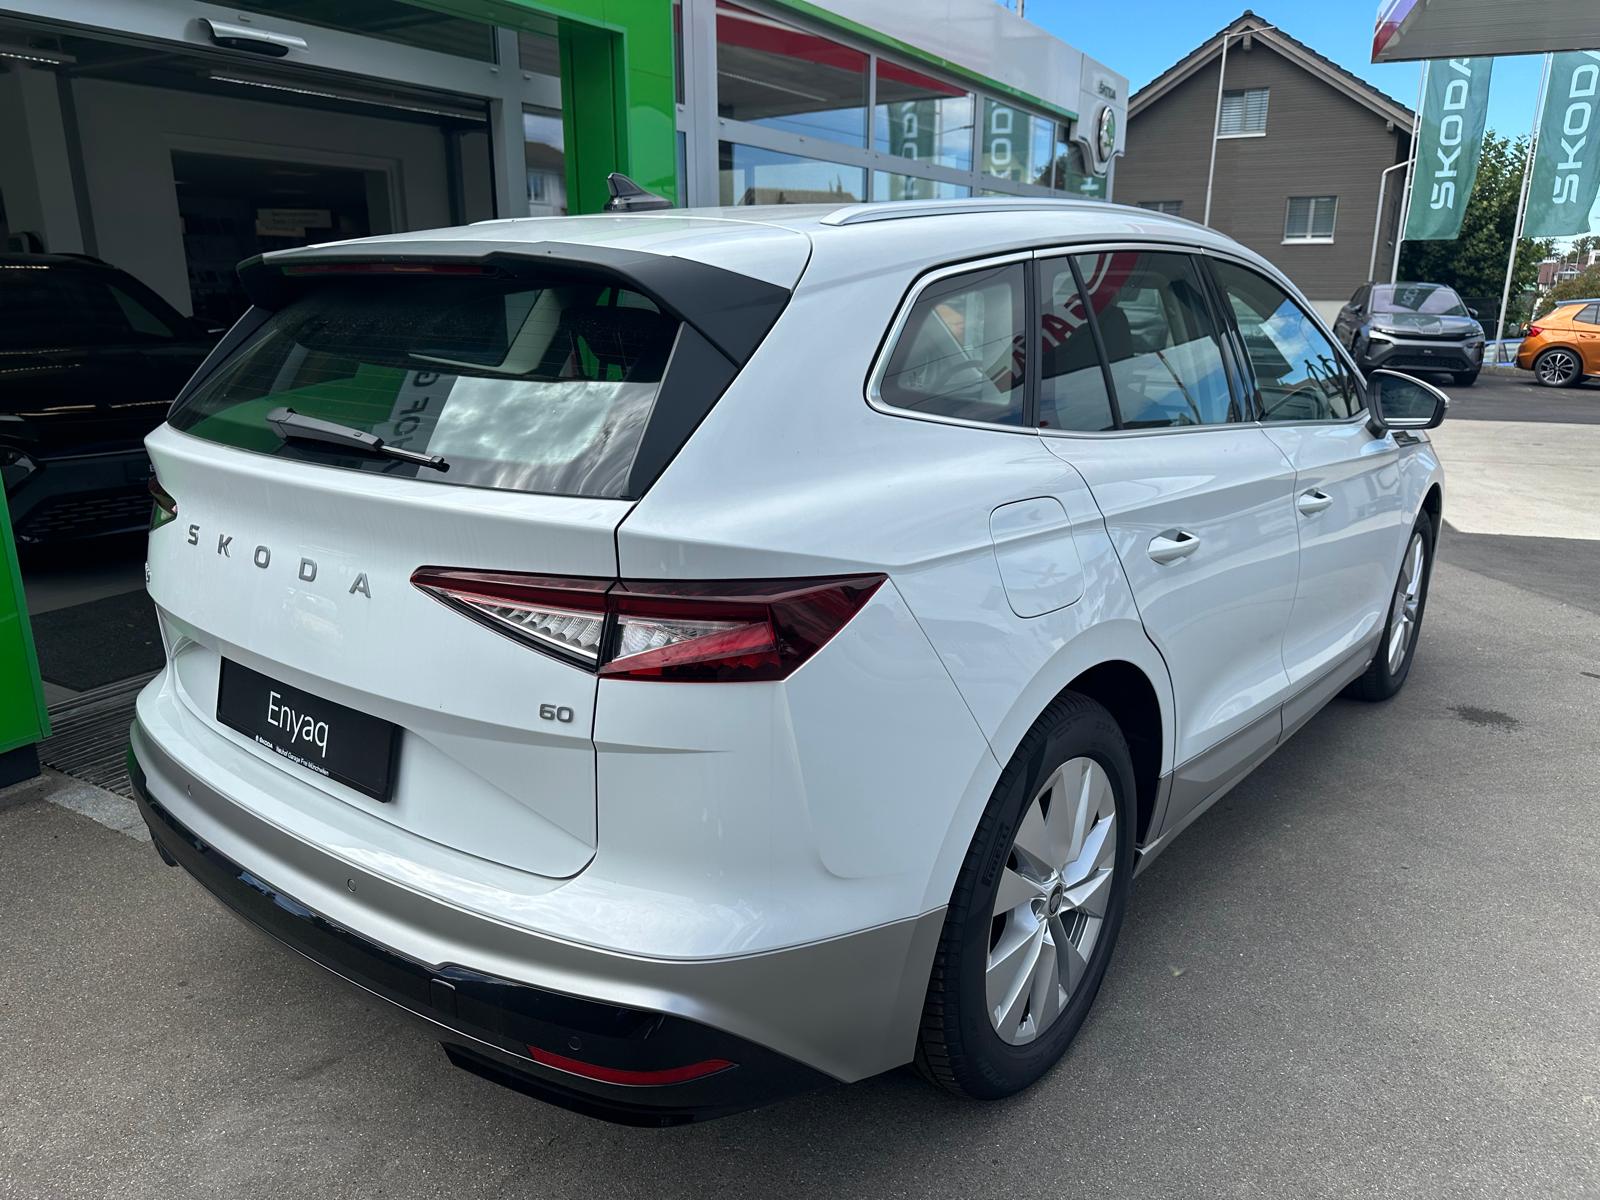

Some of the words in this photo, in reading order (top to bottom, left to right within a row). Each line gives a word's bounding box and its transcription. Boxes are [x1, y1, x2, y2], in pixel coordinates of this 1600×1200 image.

[1552, 50, 1600, 204] ŠKOD
[188, 524, 371, 599] SKODA
[267, 690, 329, 759] Enyaq
[540, 704, 574, 723] 60
